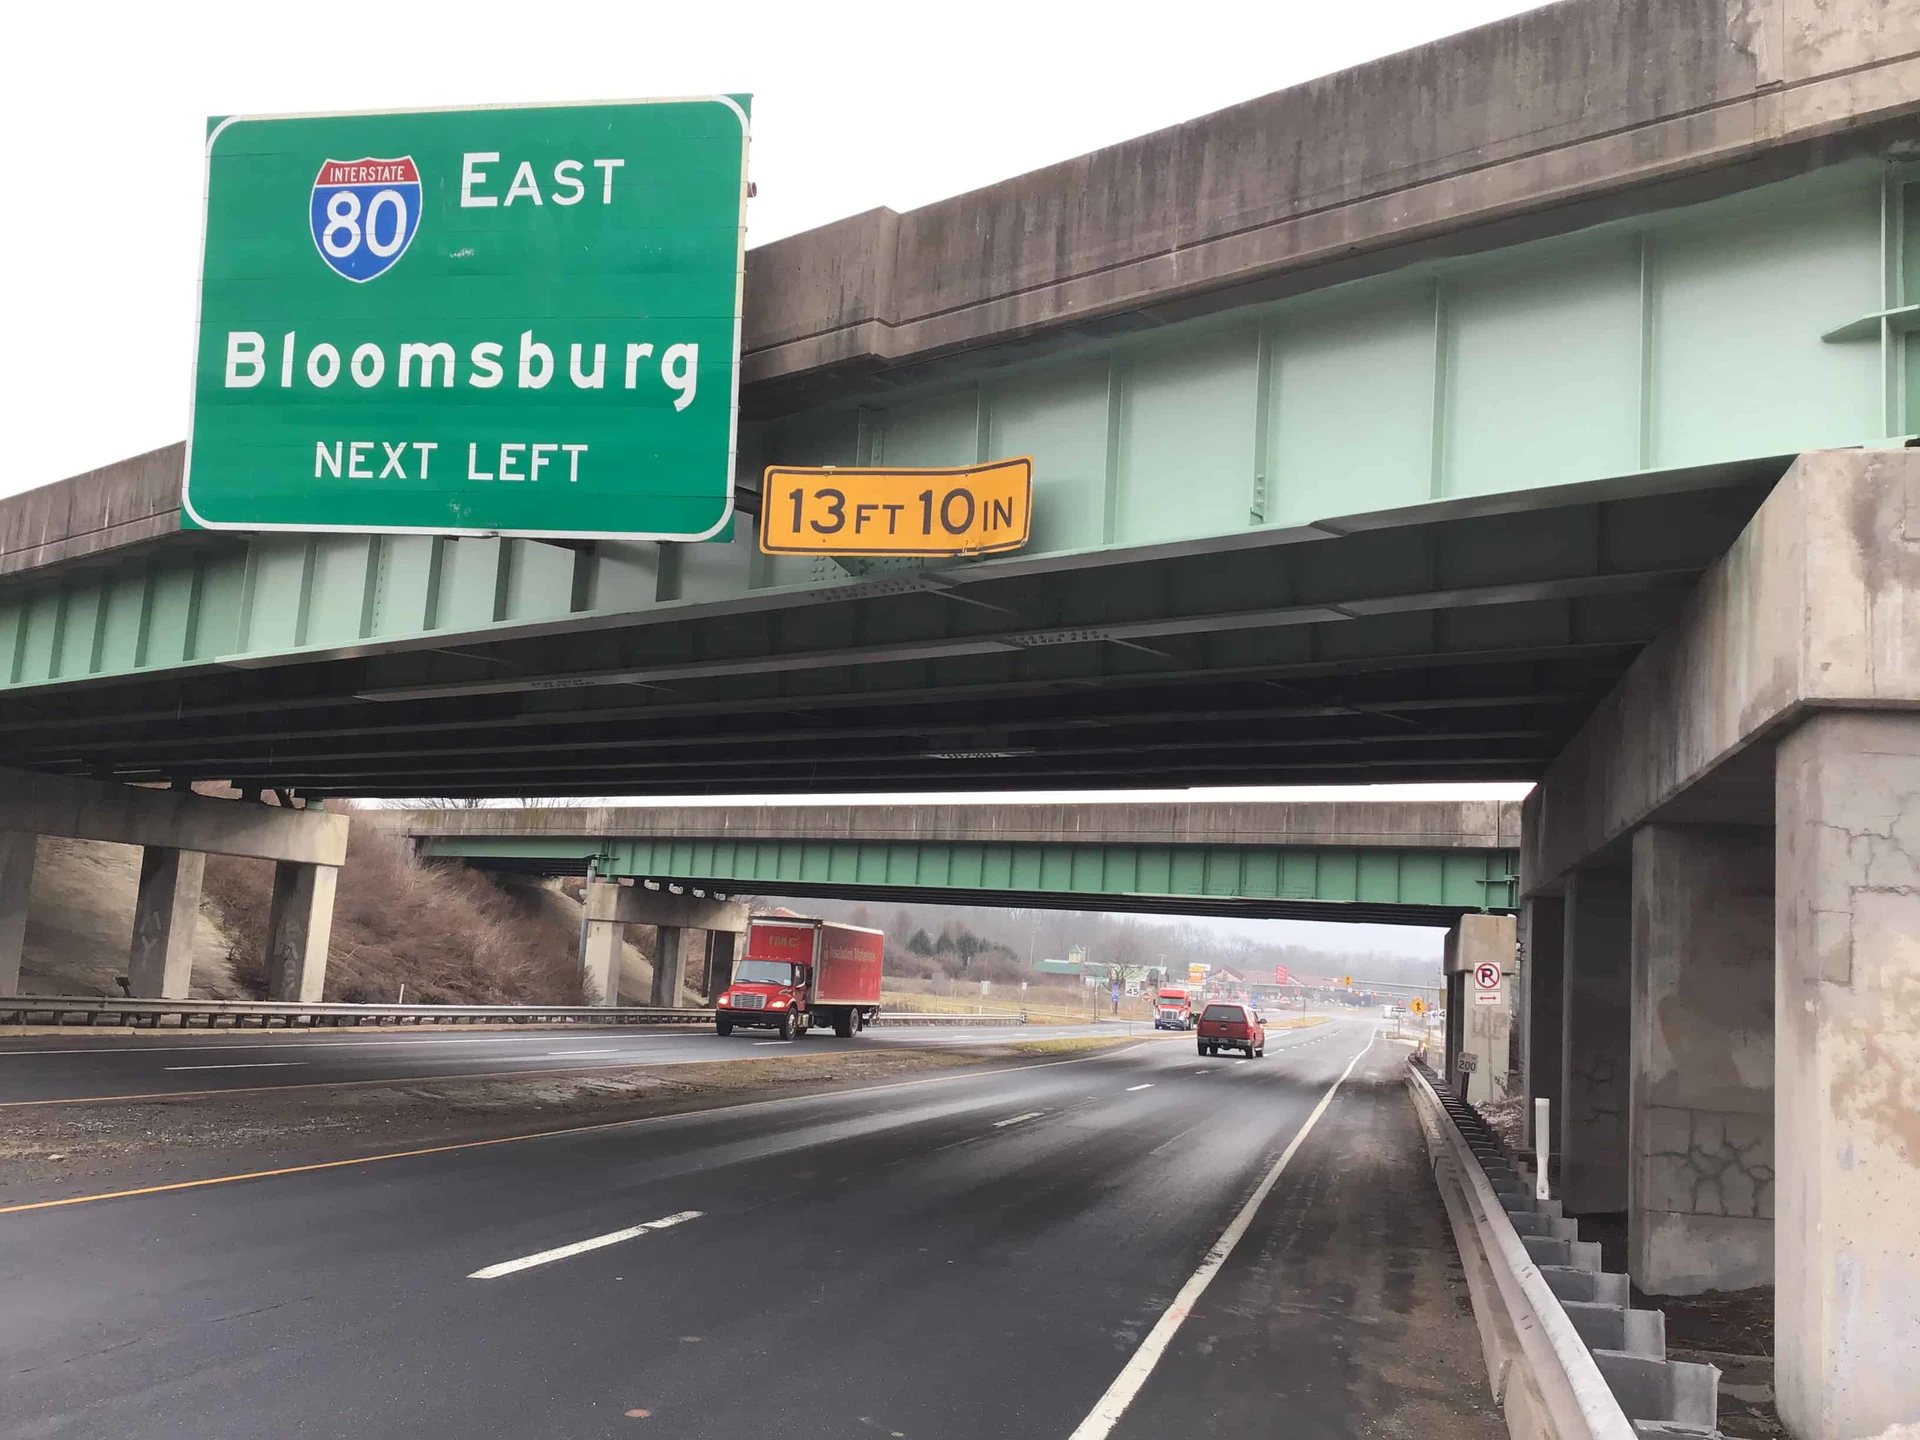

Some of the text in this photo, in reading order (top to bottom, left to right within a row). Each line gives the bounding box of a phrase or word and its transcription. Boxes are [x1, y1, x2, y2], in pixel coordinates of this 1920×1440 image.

[329, 165, 405, 182] INTERSTATE
[460, 151, 625, 208] EAST
[322, 189, 407, 258] 80
[224, 329, 699, 412] Bloomsburg
[314, 441, 588, 482] NEXT LEFT
[789, 488, 1013, 535] 13 FT 10 IN
[1126, 988, 1139, 996] 45
[1459, 1059, 1477, 1071] 200
